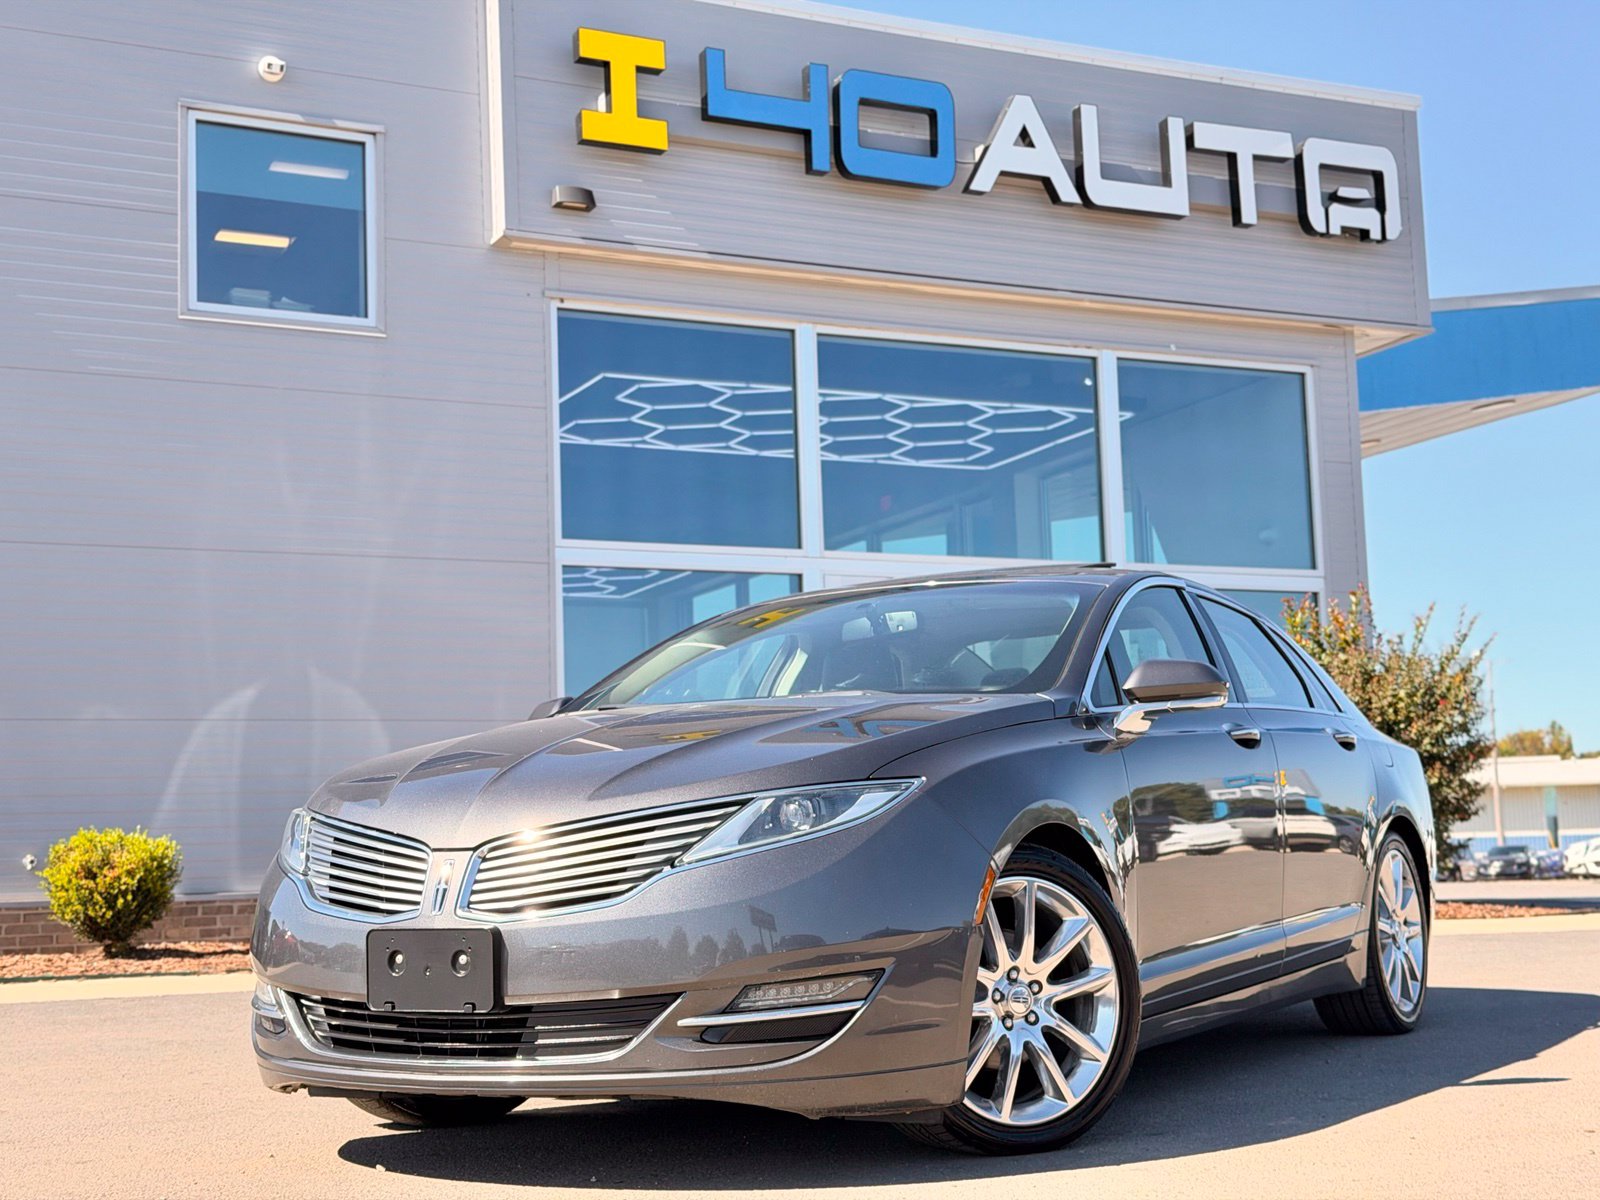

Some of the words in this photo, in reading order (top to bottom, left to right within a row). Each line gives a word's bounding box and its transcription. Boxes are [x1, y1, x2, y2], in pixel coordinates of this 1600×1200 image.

[575, 27, 669, 154] I
[700, 46, 956, 189] 40
[966, 94, 1402, 243] AUTO
